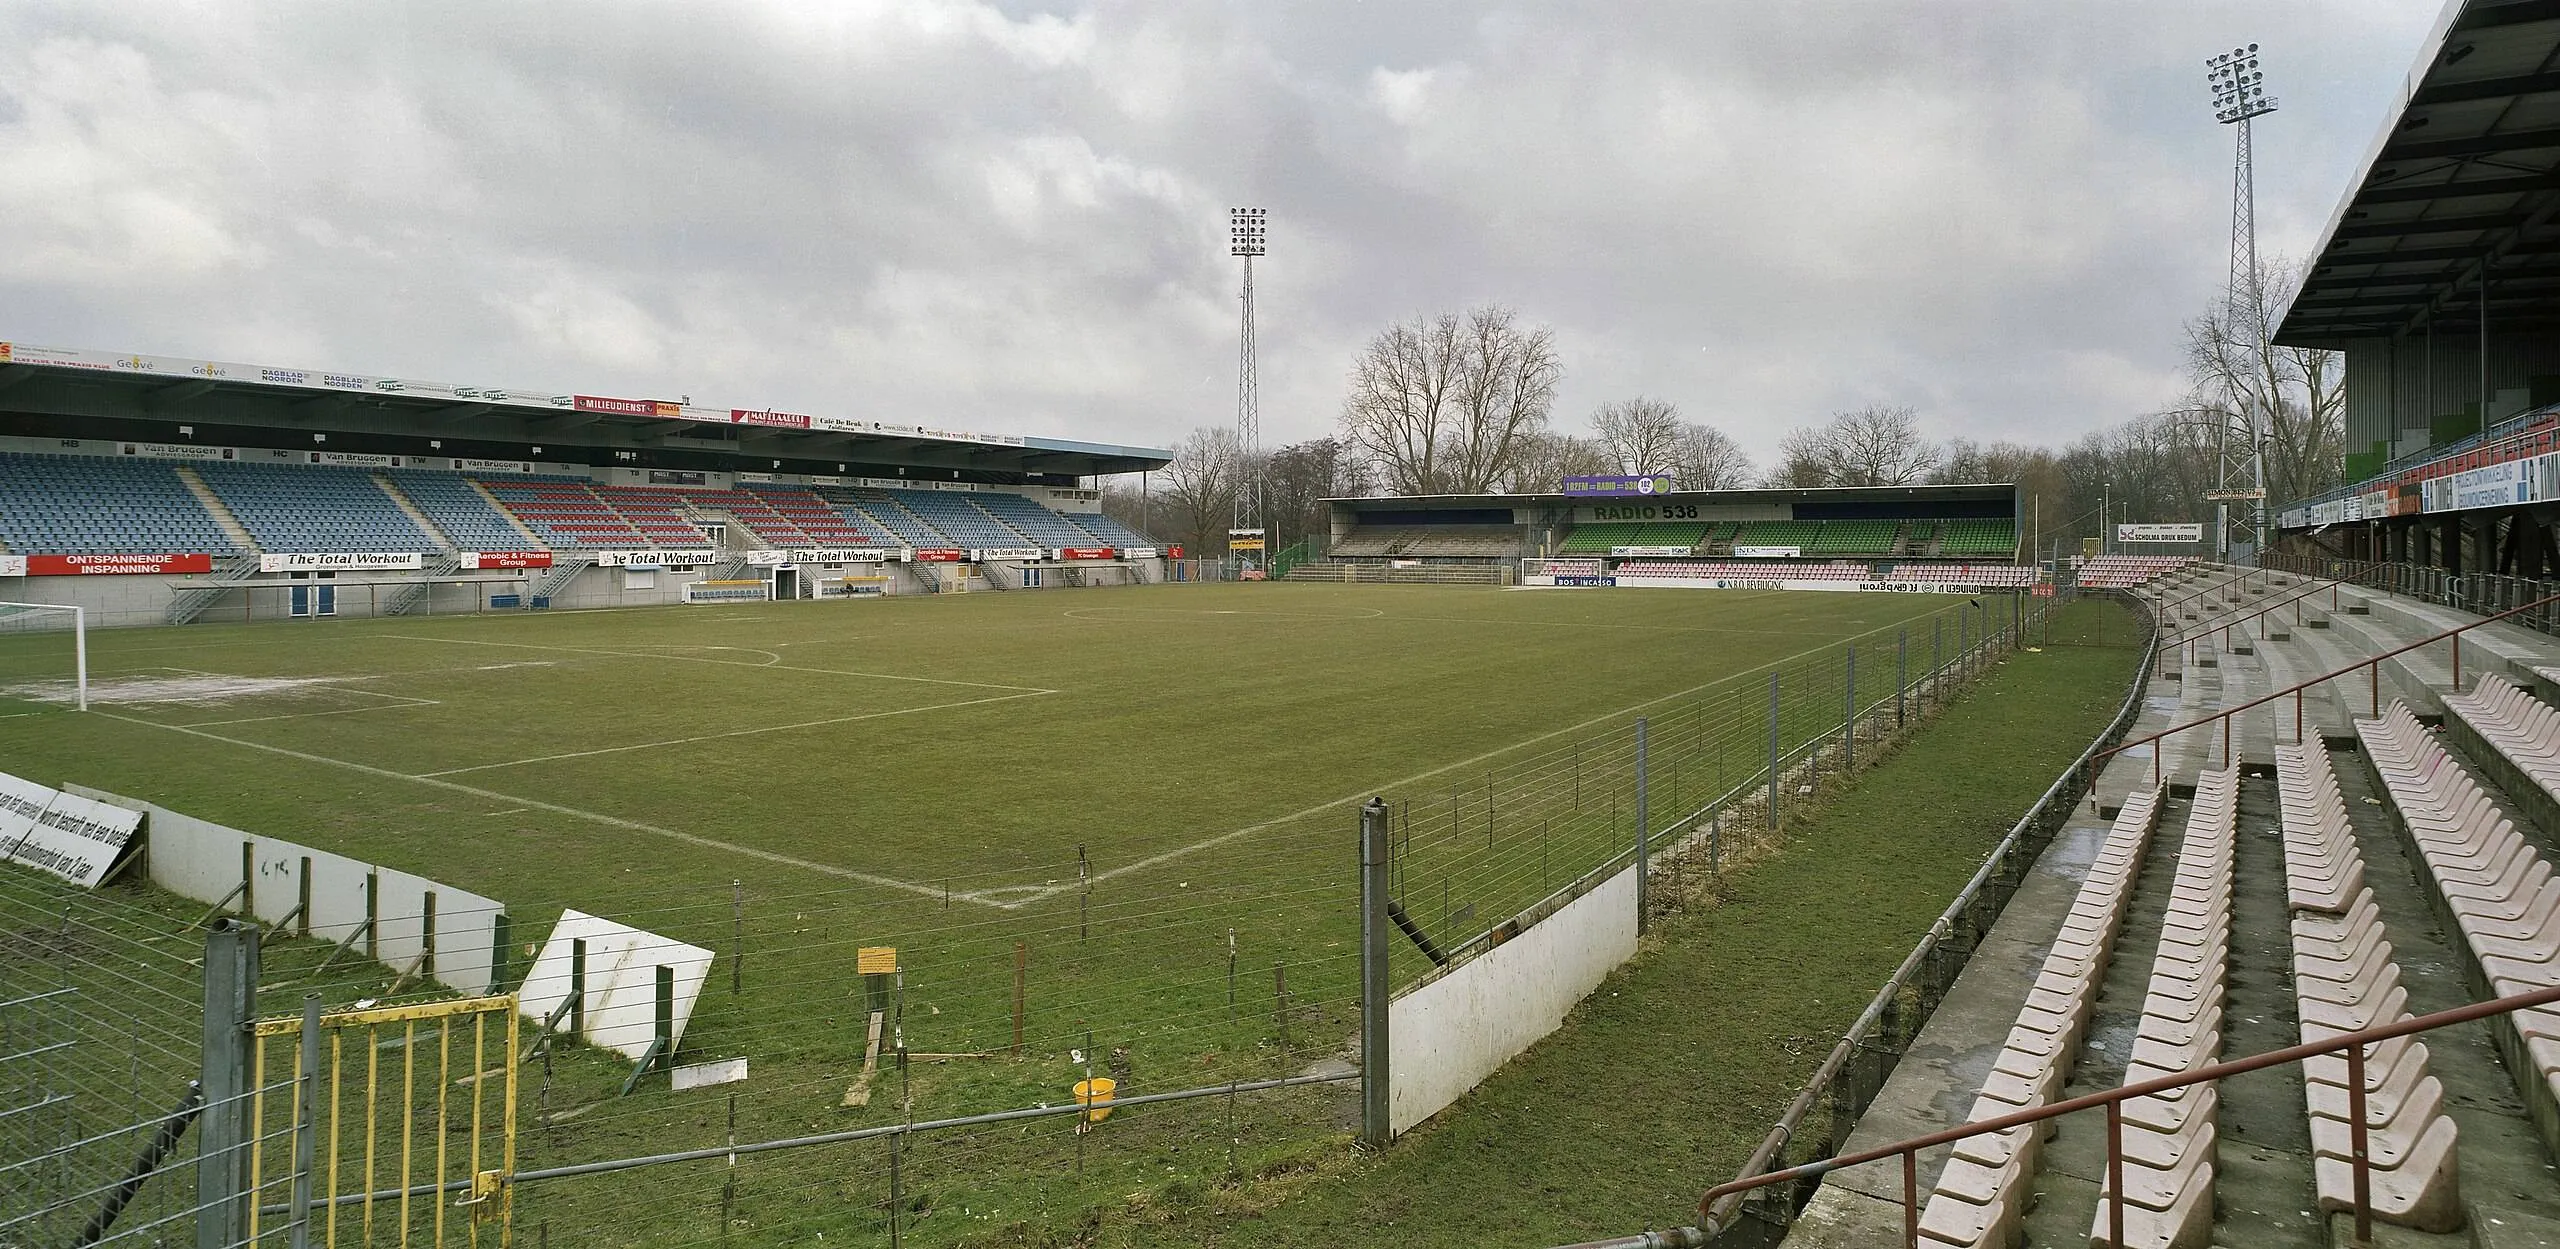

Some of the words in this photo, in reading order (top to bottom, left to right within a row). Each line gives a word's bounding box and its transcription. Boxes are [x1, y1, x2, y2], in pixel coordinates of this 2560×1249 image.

[117, 358, 154, 370] Geové
[192, 366, 226, 377] Geové
[262, 369, 303, 378] DAGBLAD
[262, 376, 303, 384] NOORDEN
[324, 375, 362, 383] DAGBLAD
[324, 381, 362, 389] NOORDEN
[586, 399, 646, 413] MILIEUDIENST
[144, 444, 165, 452] Van
[168, 445, 217, 455] Bruggen
[273, 450, 288, 458] HC
[346, 454, 387, 463] Bruggen
[467, 459, 482, 467] Van
[484, 460, 519, 468] Bruggen
[2207, 488, 2230, 496] SIMON
[1593, 506, 1656, 520] RADIO
[1662, 505, 1698, 519] 538
[66, 555, 173, 564] ONTSPANNENDE
[288, 554, 315, 564] The
[318, 554, 351, 564] Total
[357, 554, 411, 564] Workout
[612, 552, 627, 564] he
[629, 552, 661, 564] Total
[664, 552, 714, 564] Workout
[795, 551, 814, 561] The
[816, 551, 840, 561] Total
[843, 551, 883, 561] Workout
[500, 559, 527, 567] Group
[81, 565, 160, 574] INSPANNING
[1909, 583, 1918, 592] FC
[1946, 584, 1979, 593] ONINGEN
[55, 810, 87, 834] bestraft
[78, 820, 100, 837] met
[91, 825, 110, 841] een
[103, 825, 131, 847] boete
[70, 858, 94, 880] jaar
